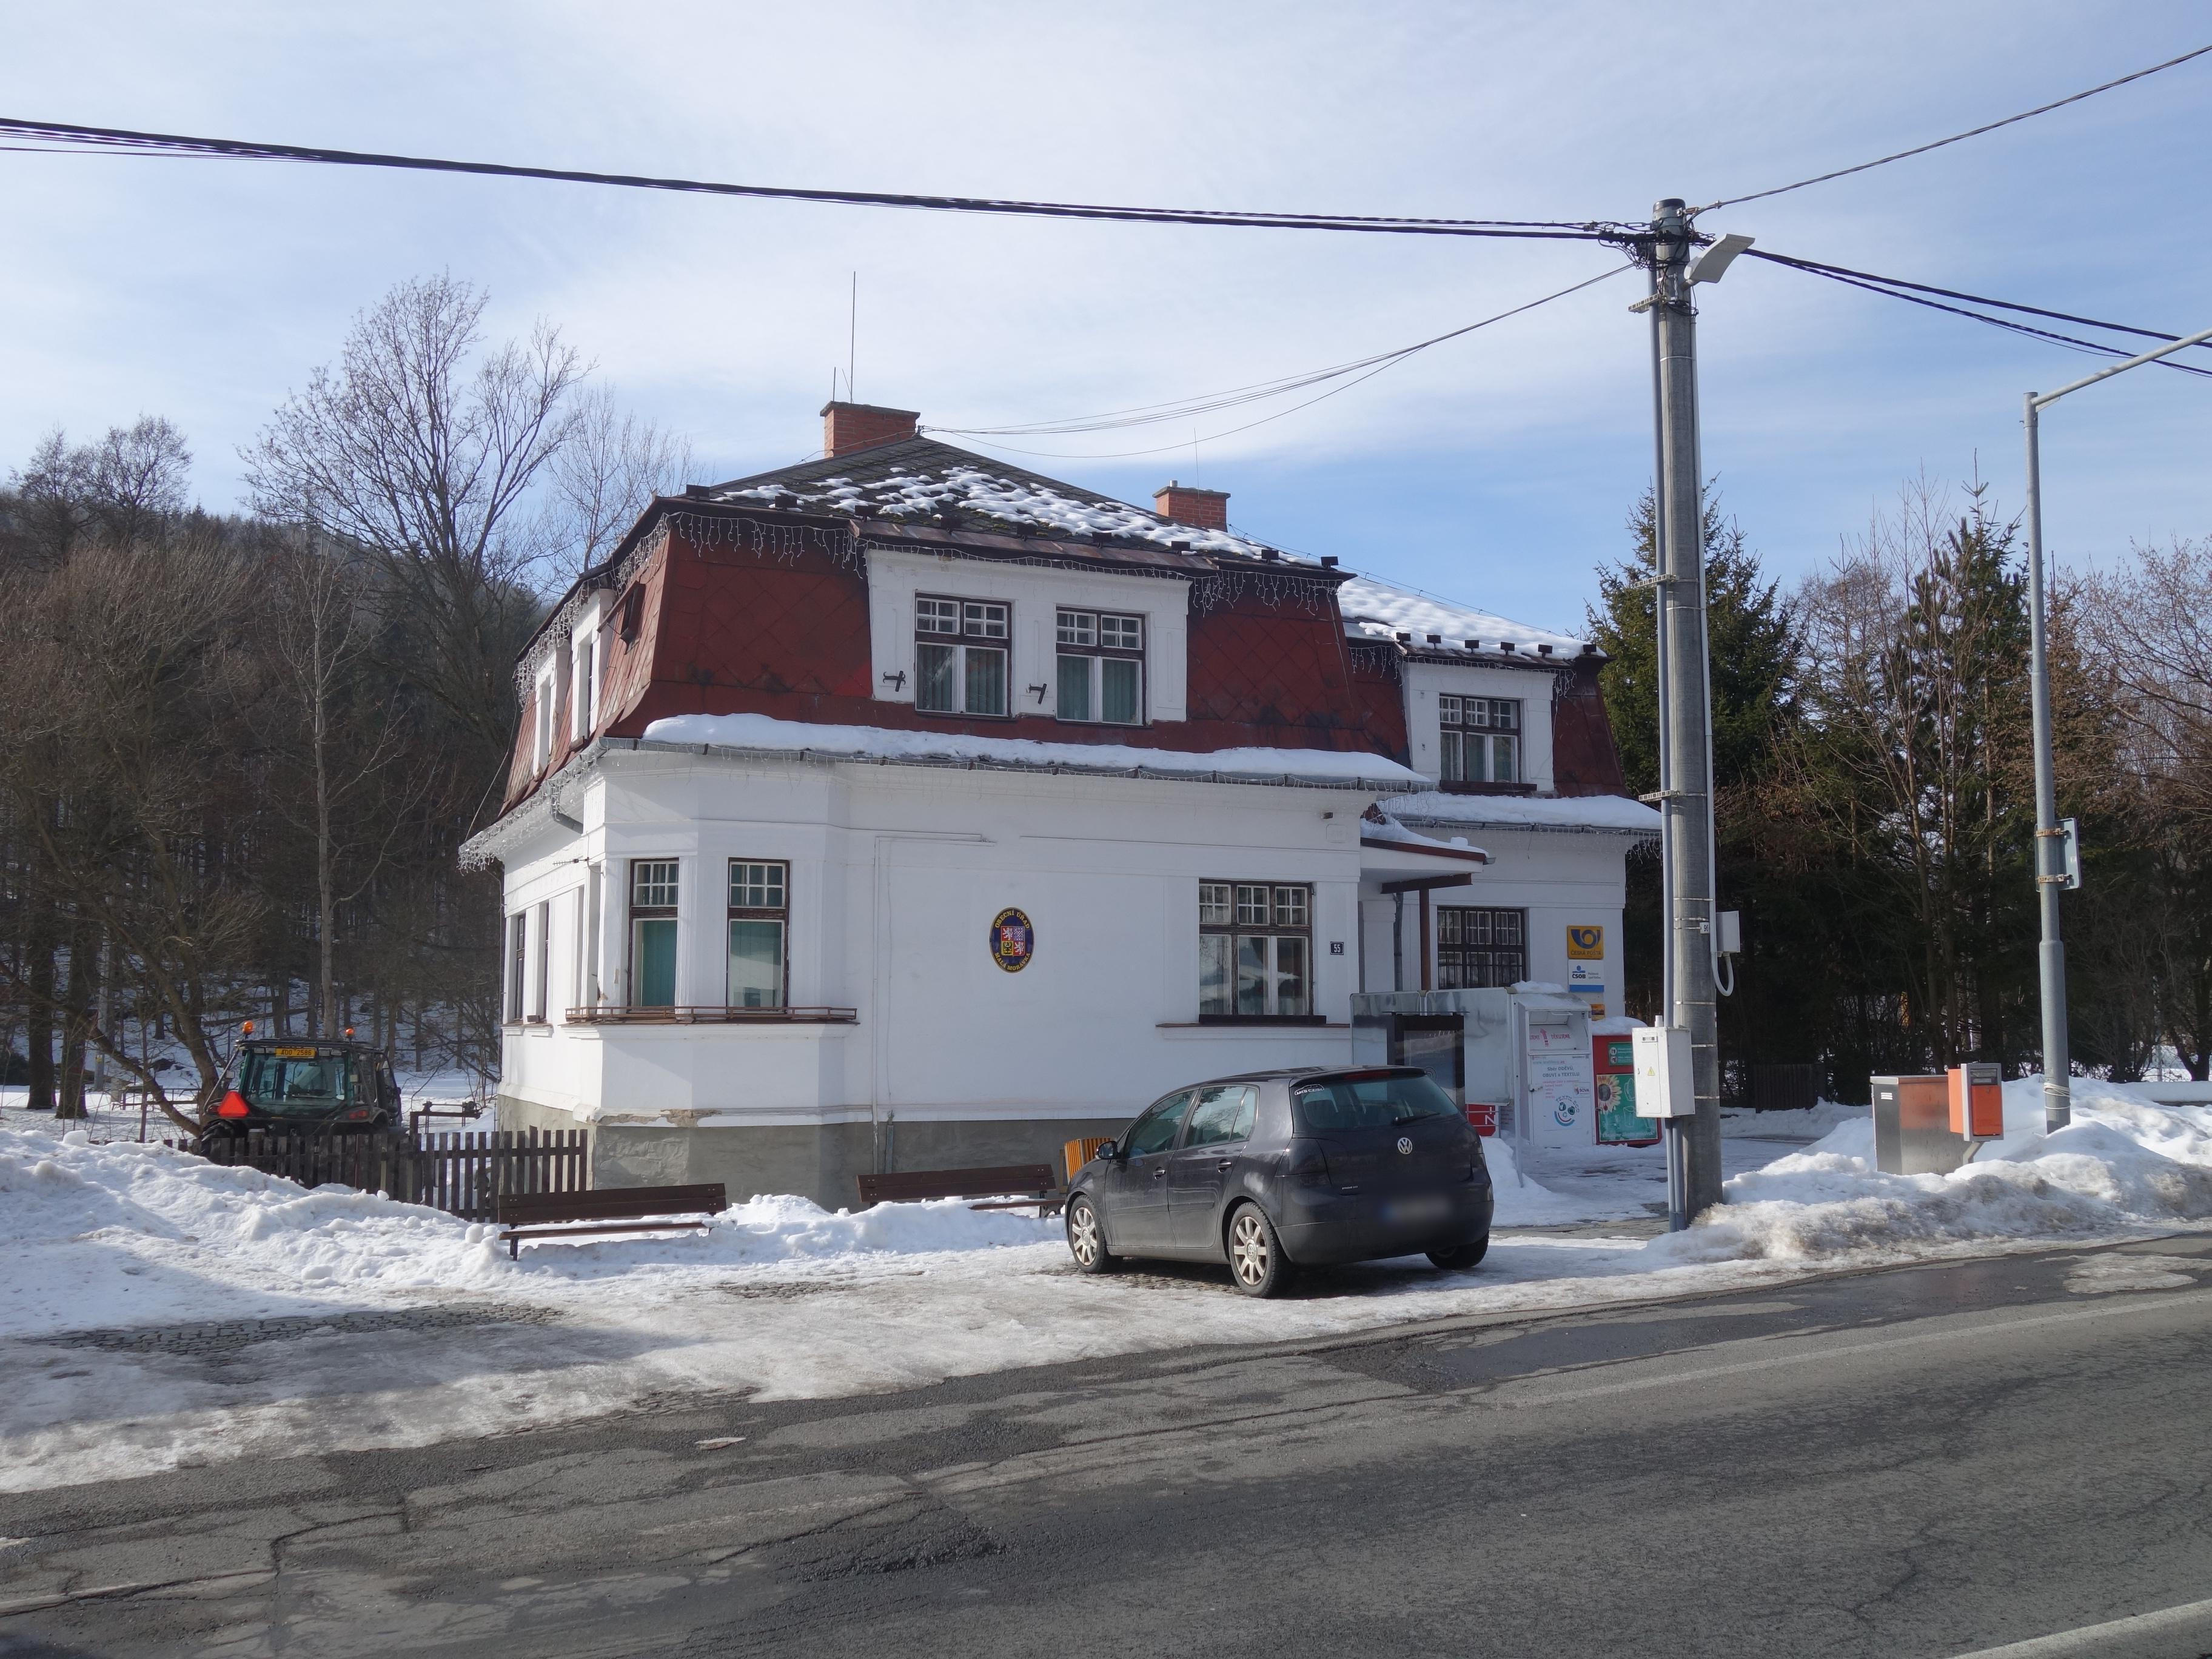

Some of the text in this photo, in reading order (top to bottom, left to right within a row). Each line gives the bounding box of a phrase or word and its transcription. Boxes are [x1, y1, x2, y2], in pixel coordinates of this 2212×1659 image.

[994, 910, 1015, 928] OBECNÍ
[1333, 943, 1341, 953] 55
[994, 952, 1031, 971] MALÁ MORÁVKA
